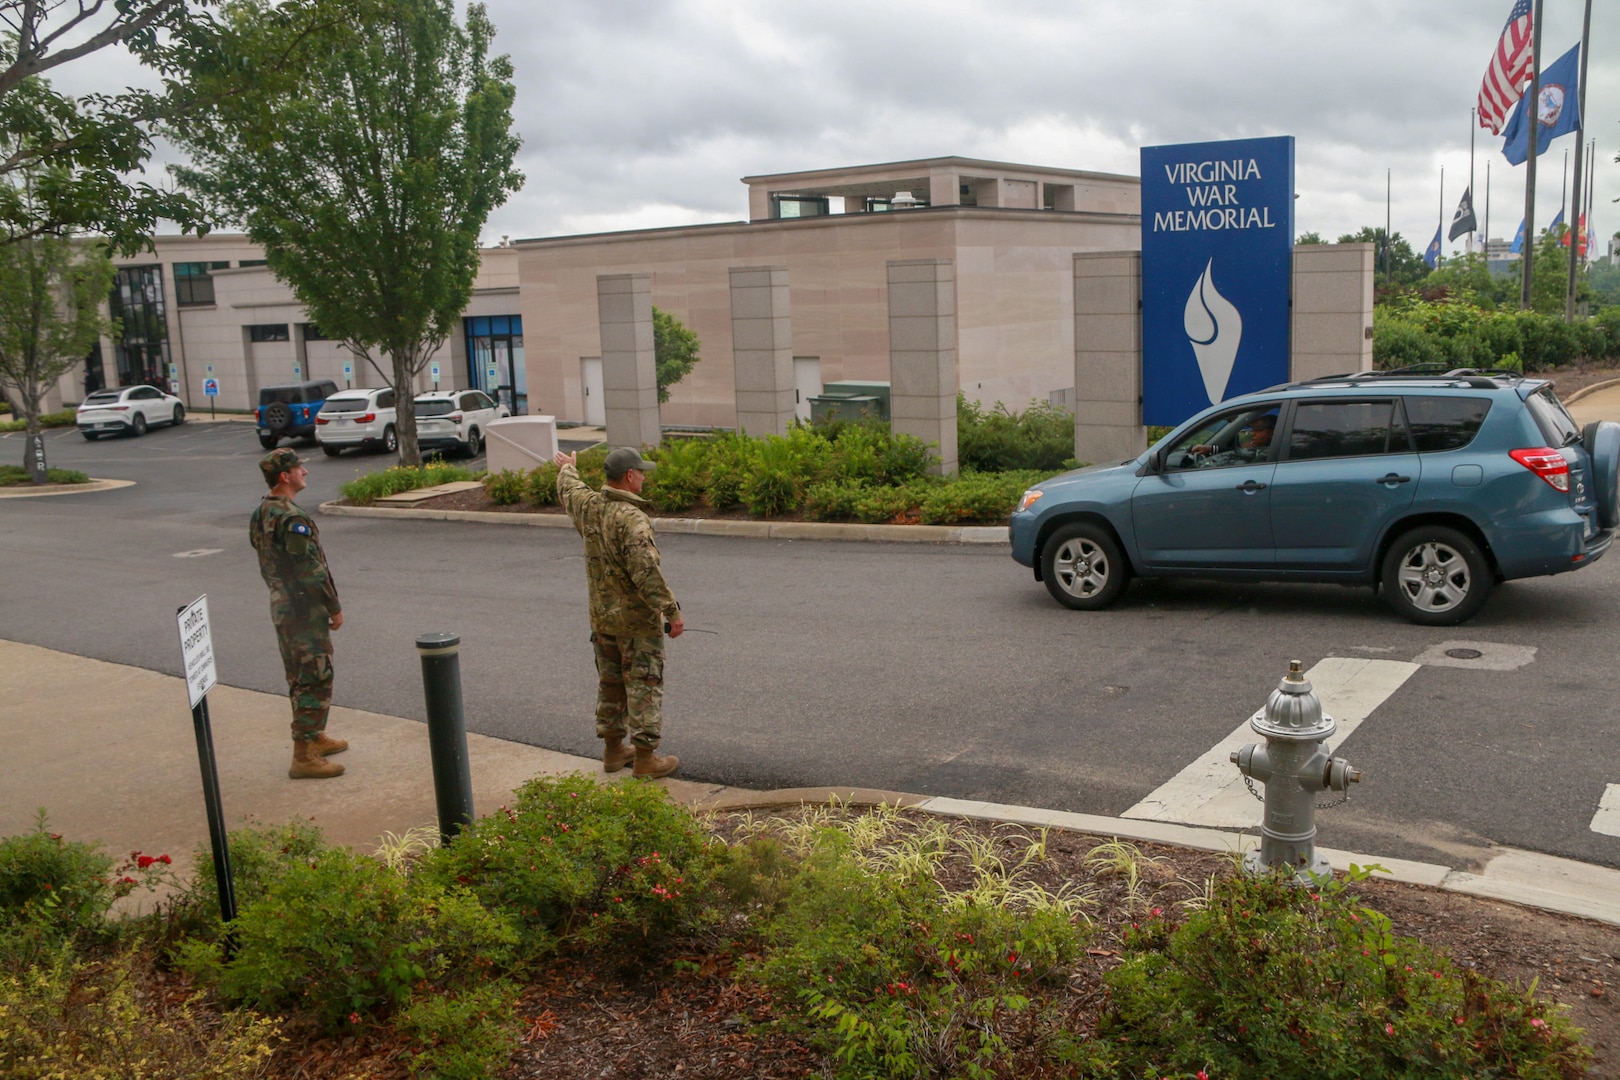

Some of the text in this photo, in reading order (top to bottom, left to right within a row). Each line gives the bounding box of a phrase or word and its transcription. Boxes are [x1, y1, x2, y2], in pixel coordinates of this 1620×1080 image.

[1164, 159, 1262, 185] VIRGINIA
[1186, 184, 1239, 207] WAR
[1153, 207, 1276, 232] MEMORIAL
[184, 623, 209, 654] PROPERTY
